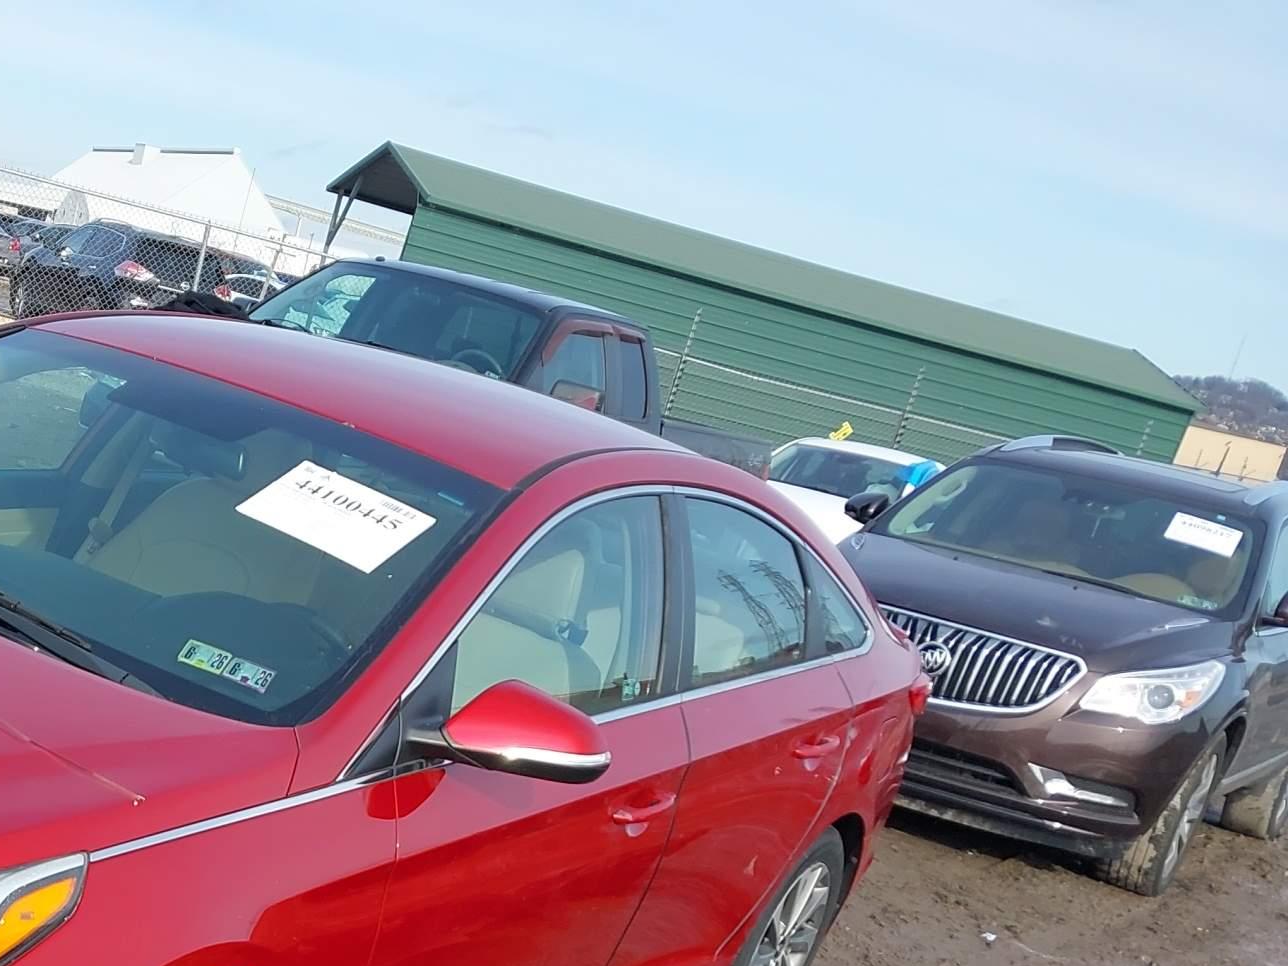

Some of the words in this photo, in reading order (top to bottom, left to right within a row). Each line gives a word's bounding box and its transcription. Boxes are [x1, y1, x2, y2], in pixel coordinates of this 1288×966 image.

[295, 480, 403, 530] 44100445
[210, 653, 229, 670] 26
[254, 670, 273, 688] 26
